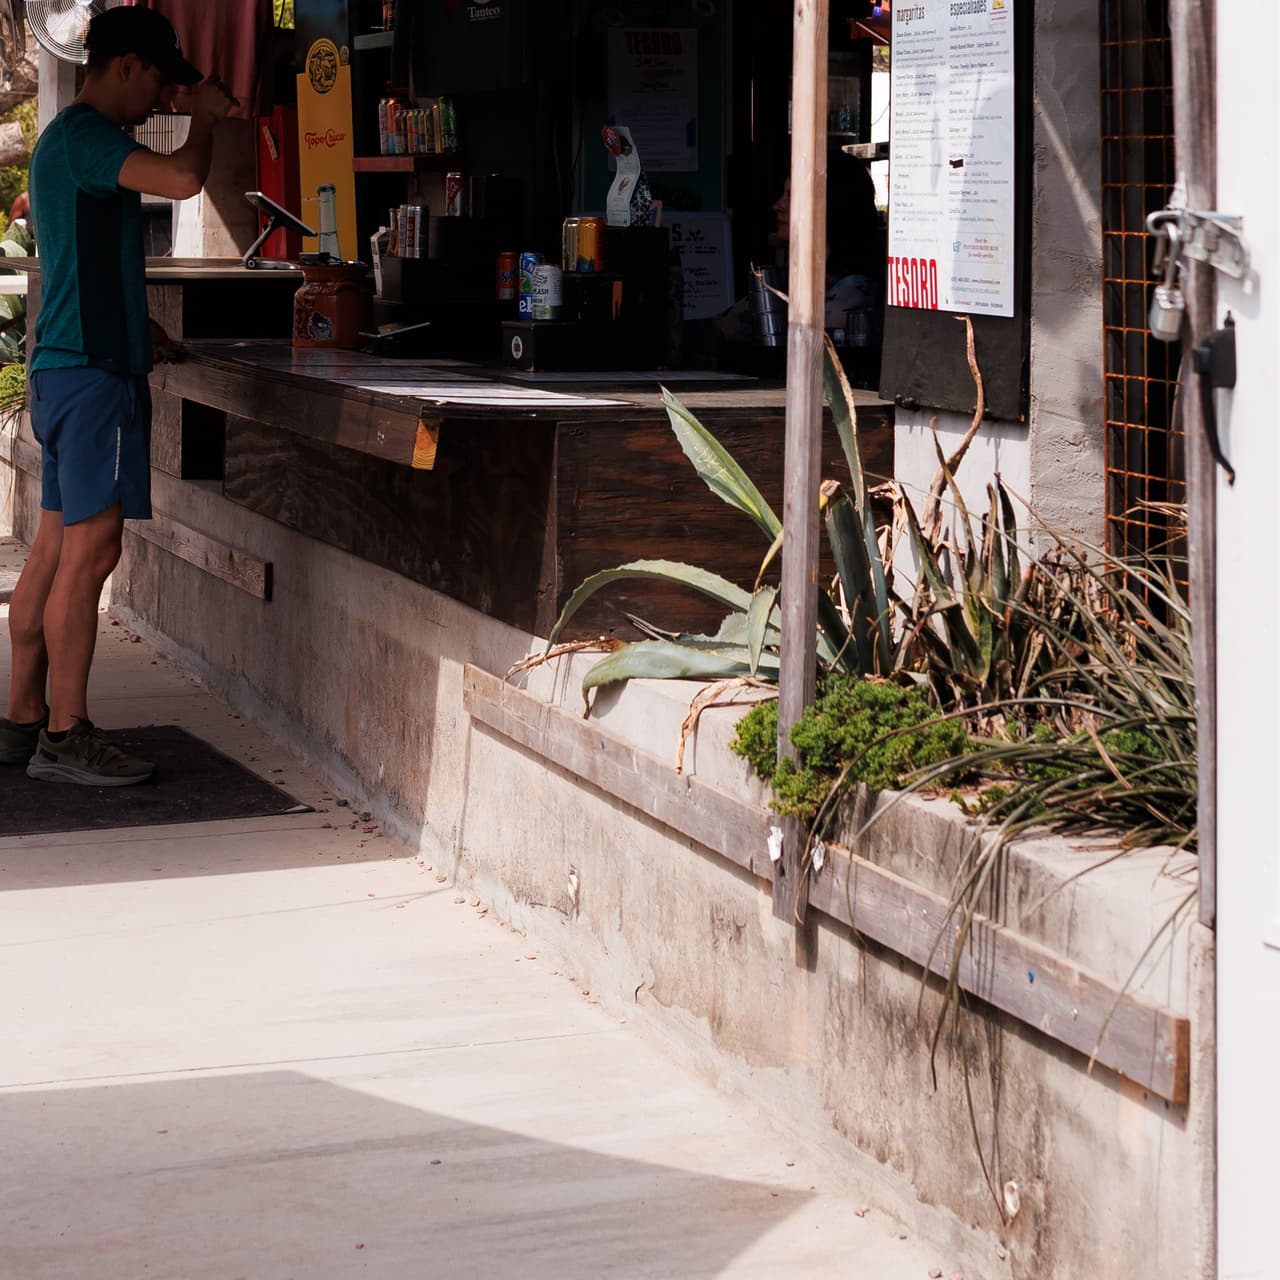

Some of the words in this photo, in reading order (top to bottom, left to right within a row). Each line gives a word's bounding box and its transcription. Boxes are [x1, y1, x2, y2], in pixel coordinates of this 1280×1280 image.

[467, 5, 501, 19] Tanteo
[896, 4, 925, 25] margaritas
[304, 129, 326, 150] Topo
[325, 128, 347, 148] Chico
[888, 256, 938, 310] TESORO
